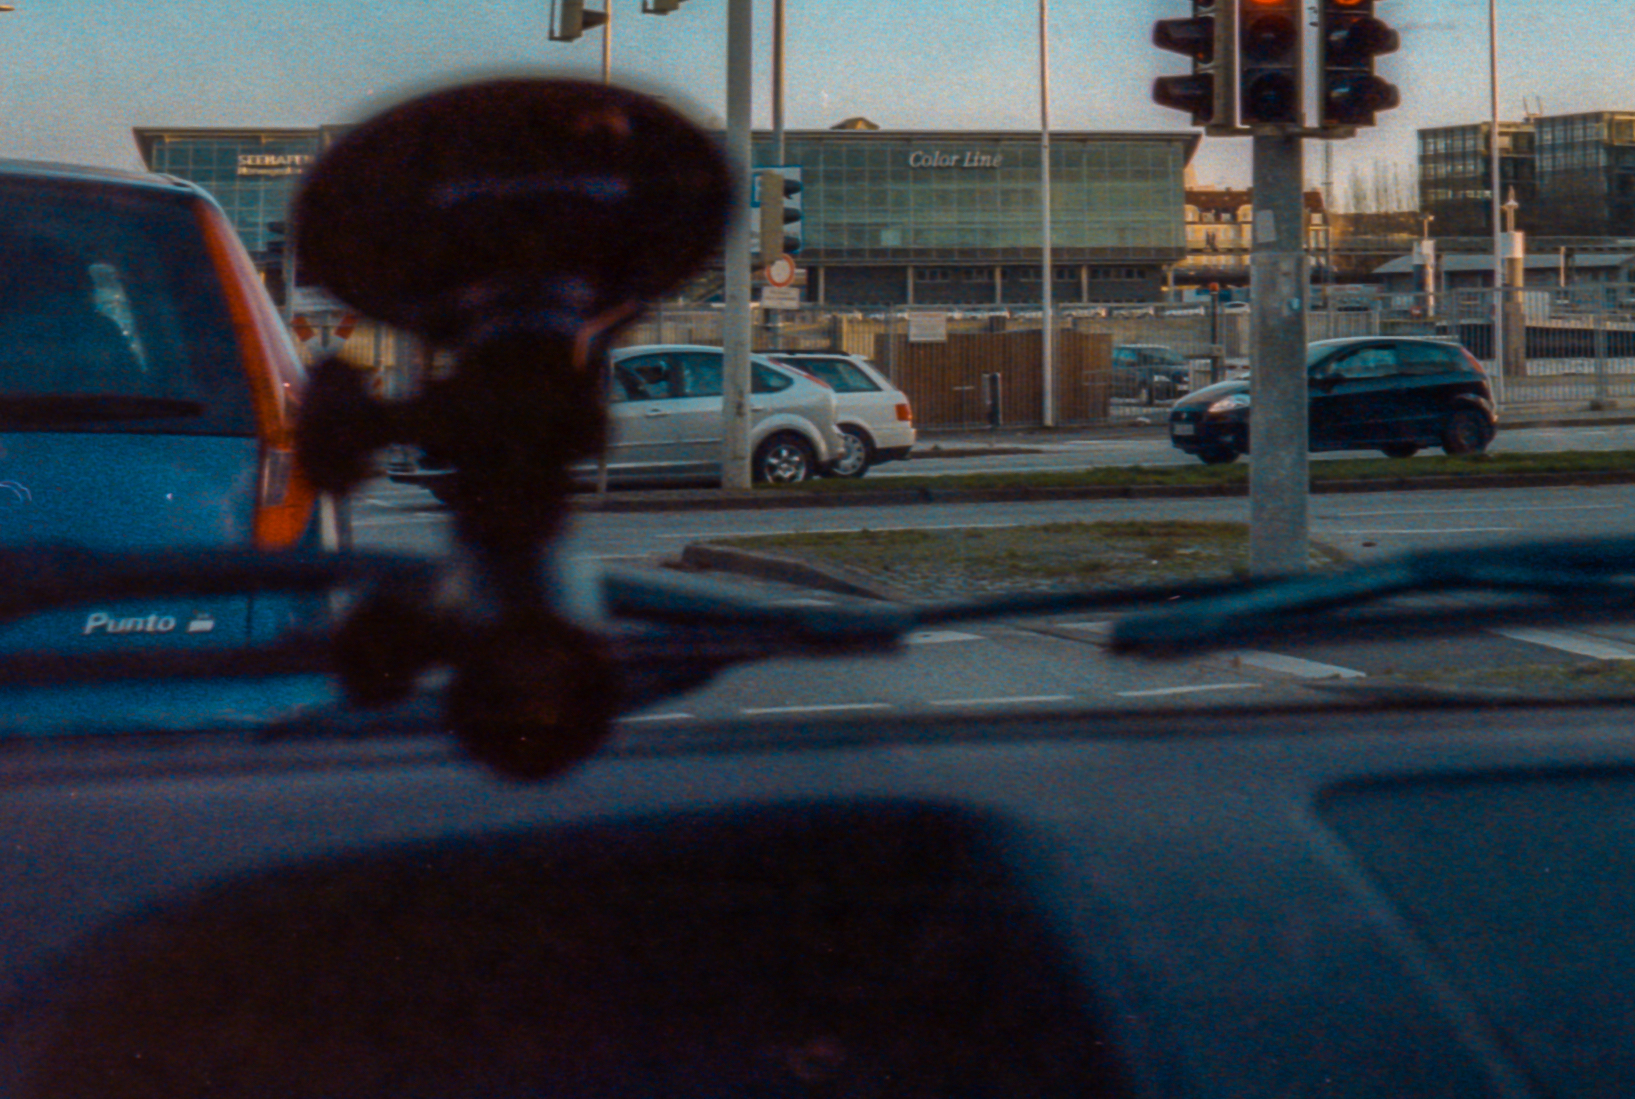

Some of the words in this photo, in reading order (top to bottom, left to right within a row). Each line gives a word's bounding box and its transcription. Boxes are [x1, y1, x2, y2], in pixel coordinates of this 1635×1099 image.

[909, 150, 959, 168] Color
[963, 150, 1003, 168] Line
[84, 612, 177, 635] Punto
